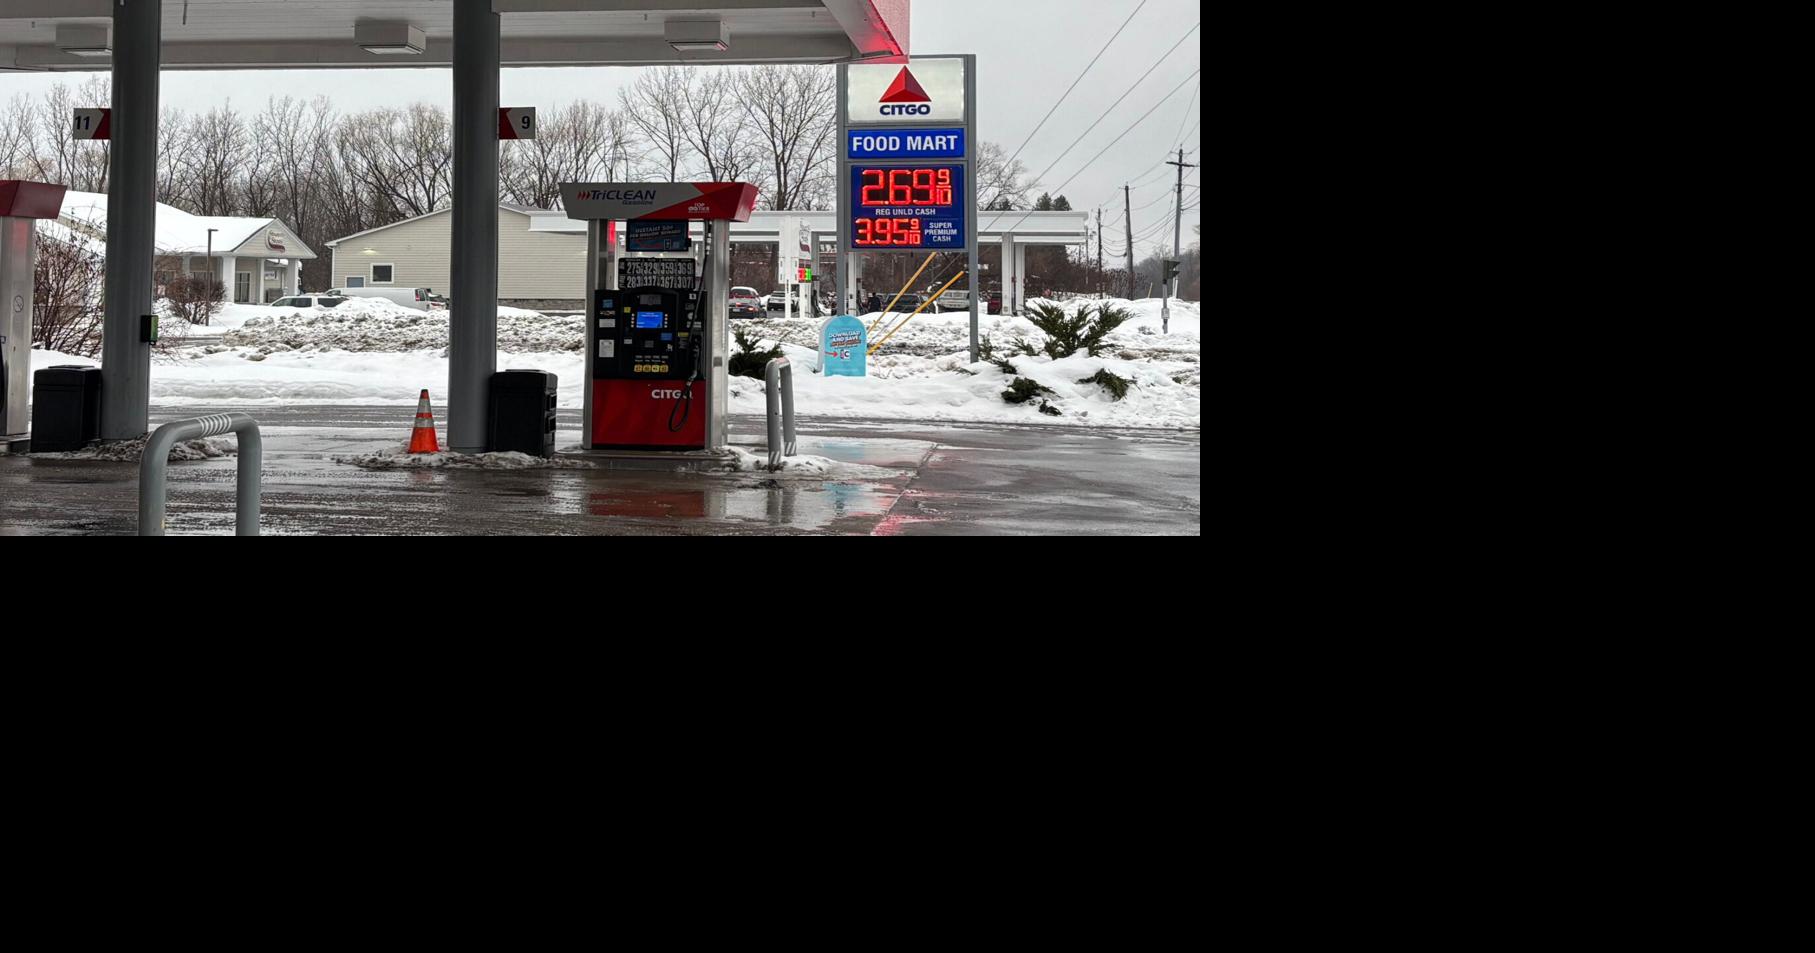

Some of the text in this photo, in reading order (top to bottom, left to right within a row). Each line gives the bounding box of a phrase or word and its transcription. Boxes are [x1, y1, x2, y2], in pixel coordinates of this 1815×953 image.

[879, 104, 931, 116] CITGO
[75, 115, 90, 130] 11
[521, 115, 531, 130] 9
[852, 135, 958, 151] FOOD MART
[591, 190, 657, 200] TriCLEAN
[861, 169, 936, 206] 2.69
[855, 218, 909, 245] 3.95
